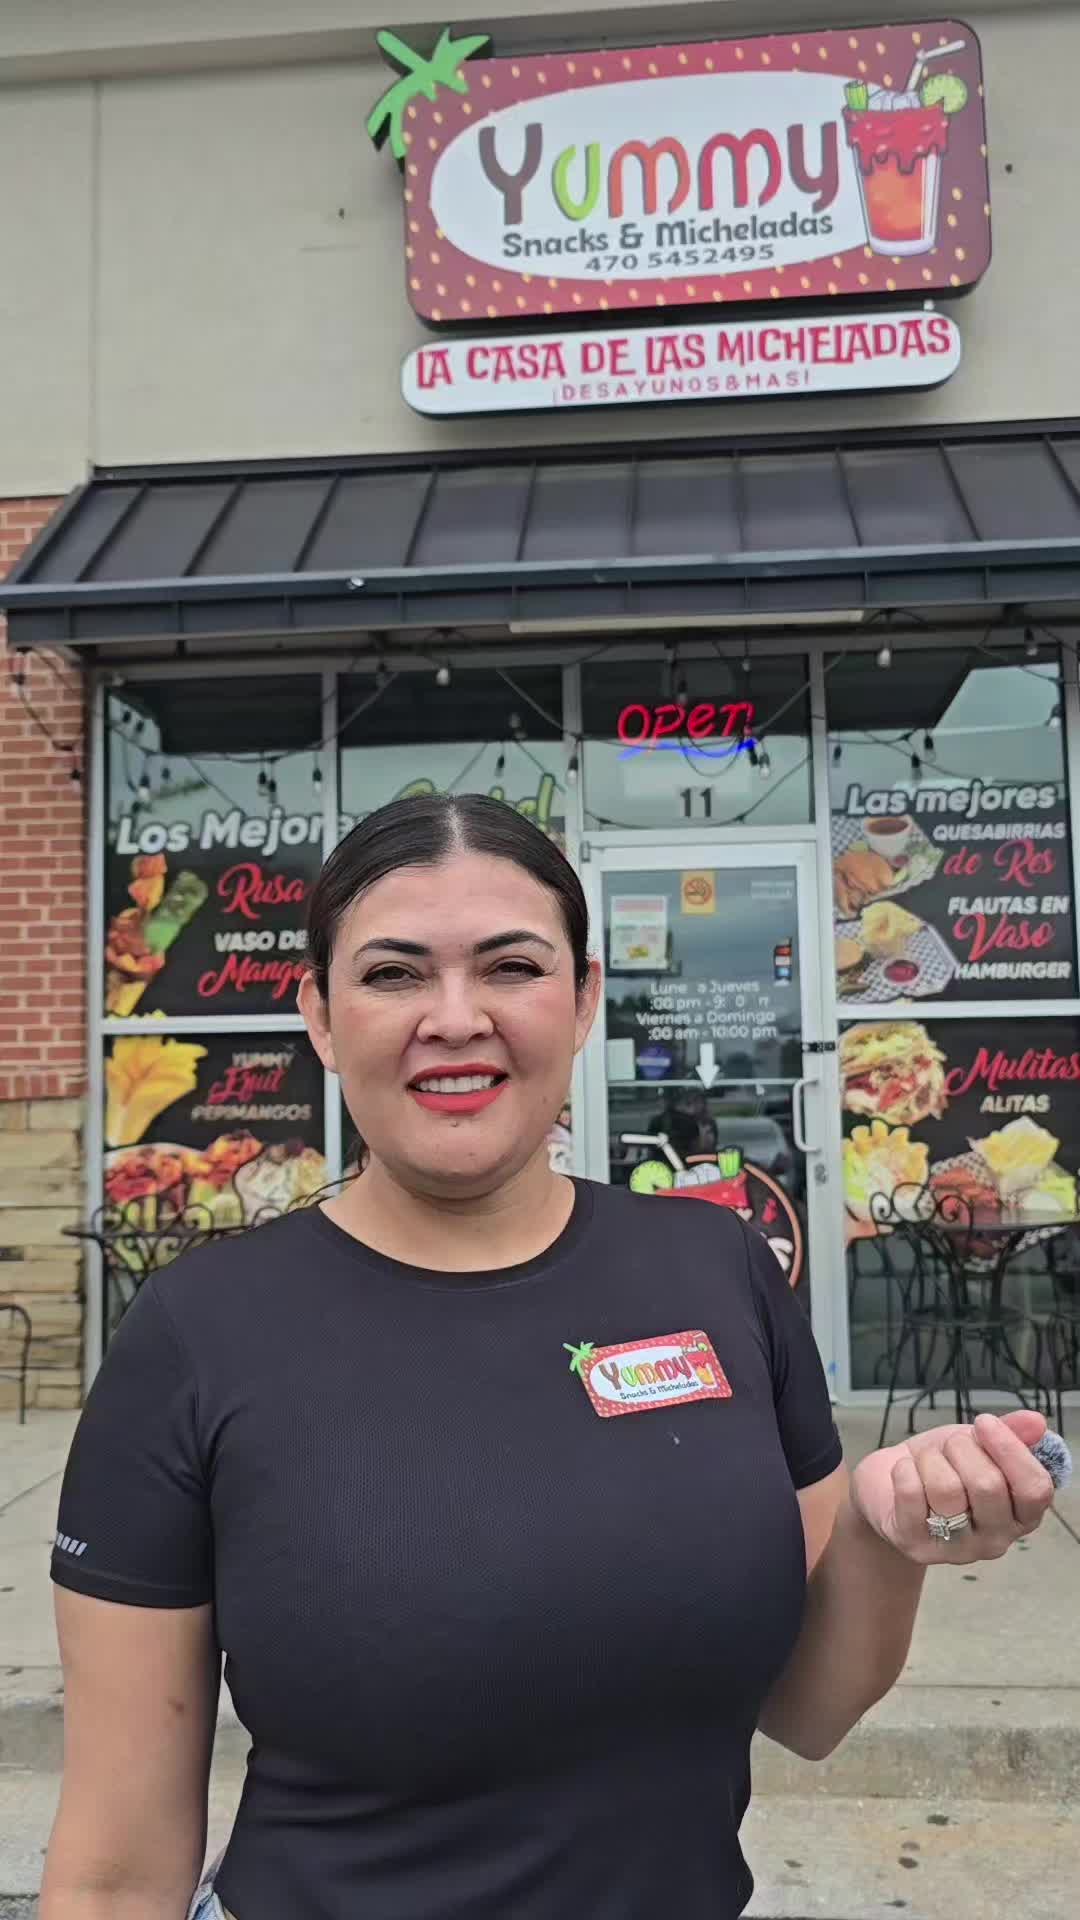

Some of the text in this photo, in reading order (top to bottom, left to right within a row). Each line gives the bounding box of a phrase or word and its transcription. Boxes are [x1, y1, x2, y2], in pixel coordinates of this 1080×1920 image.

[477, 120, 841, 226] Yummy
[502, 212, 834, 259] Snacks & Micheladas
[585, 243, 775, 272] 470 5452495
[417, 318, 951, 390] LA CASA DE LAS MICHELADAS
[680, 787, 712, 818] 11
[848, 781, 1056, 818] Las mejores
[116, 807, 353, 857] Los Mejor
[932, 822, 1067, 842] QUESABIRRIAS
[943, 839, 1053, 888] de Res
[948, 896, 1069, 916] FLAUTAS EN
[215, 932, 275, 952] VASO
[953, 913, 1055, 963] Vaso
[955, 962, 1071, 980] HAMBURGER
[709, 980, 760, 994] Jueves
[635, 1011, 690, 1026] Viernes
[706, 1009, 776, 1025] Domingo
[711, 1025, 749, 1039] 10:00
[943, 1047, 1080, 1096] Mulitas
[979, 1094, 1051, 1113] ALITAS
[598, 1354, 693, 1391] Yummy
[619, 1390, 648, 1400] Snacks
[658, 1380, 699, 1393] Micheladas
